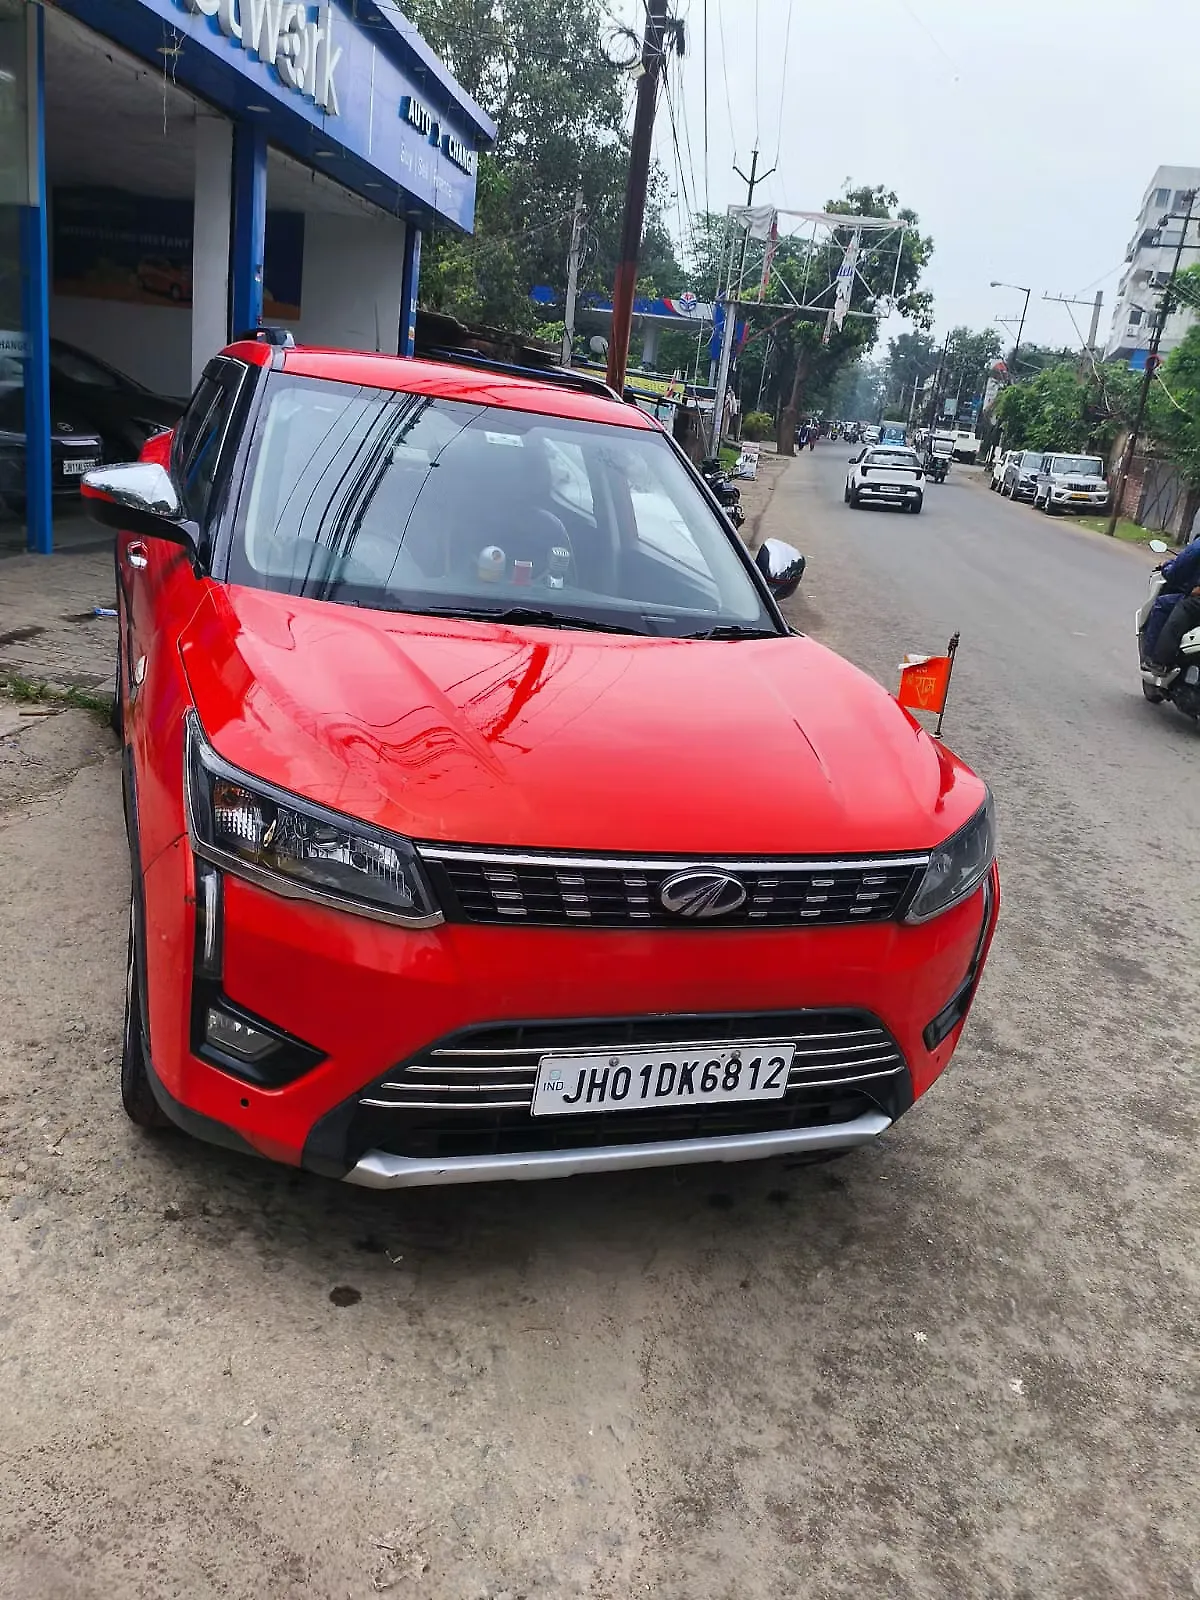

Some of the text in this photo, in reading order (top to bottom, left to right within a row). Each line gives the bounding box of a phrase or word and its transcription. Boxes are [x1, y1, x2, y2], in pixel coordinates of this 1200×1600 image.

[407, 96, 432, 136] AUTO
[542, 1081, 564, 1092] IND
[562, 1055, 786, 1104] JH01DK6812
